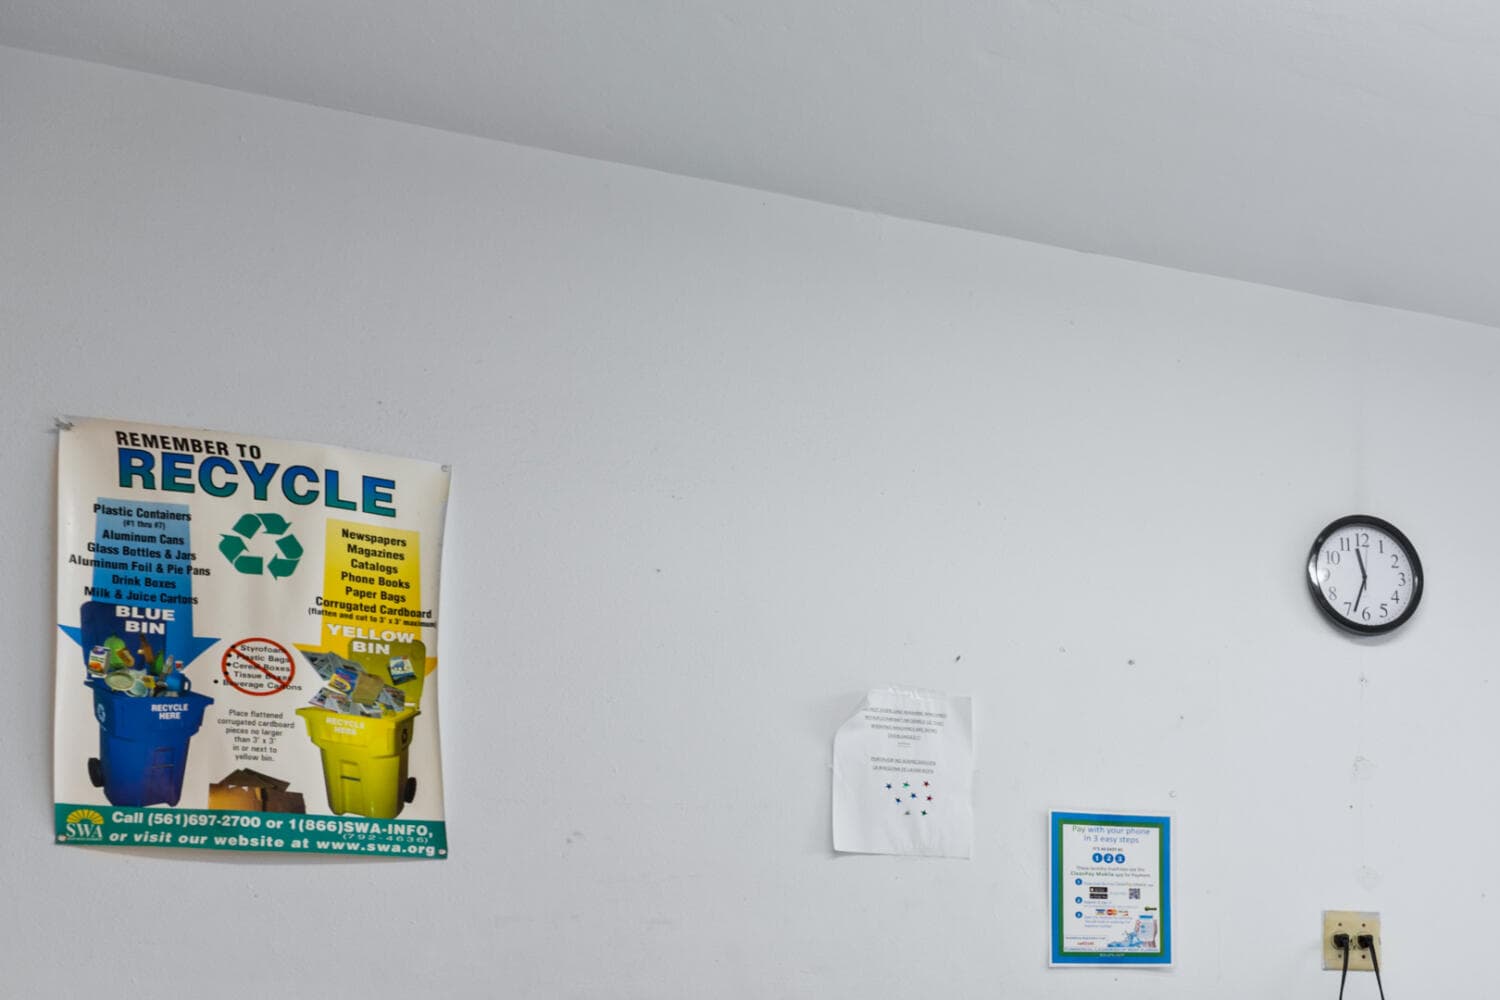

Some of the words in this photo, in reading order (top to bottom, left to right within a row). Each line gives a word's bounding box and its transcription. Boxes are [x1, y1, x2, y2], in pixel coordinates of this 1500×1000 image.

[115, 430, 229, 456] REMEMBER
[236, 443, 261, 460] TO
[117, 447, 396, 518] RECYCLE
[93, 503, 133, 517] Plastic
[136, 508, 192, 521] Containers
[137, 521, 152, 529] thru
[102, 529, 157, 543] Aluminum
[160, 534, 185, 545] Cans
[341, 528, 407, 547] Newspapers
[1340, 537, 1350, 551] 11
[1355, 532, 1370, 548] 12
[87, 542, 120, 555] Glass
[122, 546, 162, 559] Bottles
[164, 549, 172, 559] &
[175, 550, 197, 561] Jars
[347, 543, 405, 561] Magazines
[1379, 540, 1384, 554] 1
[1325, 550, 1341, 565] 10
[1391, 554, 1400, 569] 2
[69, 554, 128, 571] Aluminum
[131, 561, 152, 573] Foil
[156, 563, 164, 574] &
[167, 564, 184, 576] Pie
[187, 566, 211, 577] Pans
[351, 558, 399, 575] Catalogs
[112, 574, 141, 586] Drink
[144, 577, 177, 589] Boxes
[341, 571, 375, 585] Phone
[378, 576, 411, 590] Books
[1398, 572, 1406, 587] 3
[84, 586, 110, 599] Milk
[114, 589, 123, 600] &
[126, 590, 158, 602] Juice
[160, 593, 199, 605] Cartons
[345, 586, 377, 600] Paper
[380, 591, 407, 603] Bags
[1328, 586, 1338, 601] 8
[1391, 590, 1400, 605] 4
[115, 605, 175, 622] BLUE
[308, 607, 338, 618] (flatten
[340, 611, 353, 620] and
[356, 613, 368, 622] cut
[370, 614, 378, 622] to
[316, 596, 377, 613] Corrugated
[380, 605, 432, 619] Cardboard
[1344, 602, 1352, 616] 7
[1362, 607, 1371, 621] 6
[1379, 603, 1388, 618] 5
[125, 621, 166, 635] BIN
[327, 623, 416, 643] YELLOW
[352, 641, 390, 655] BIN
[232, 661, 262, 670] Cere
[236, 654, 266, 662] Pstic
[234, 671, 263, 679] Tissue
[223, 679, 264, 689] Bverage
[267, 682, 302, 691] Caons
[151, 704, 189, 712] RECYCLE
[229, 709, 249, 718] Place
[250, 710, 283, 719] flattened
[217, 718, 257, 727] corrugated
[258, 720, 295, 729] cardboard
[261, 729, 282, 738] larger
[235, 753, 259, 761] yellow
[66, 823, 103, 838] SWA
[112, 811, 143, 824] Call
[147, 813, 261, 828] (561)697-2700
[266, 818, 283, 829] or
[289, 817, 433, 838] 1(866)SWA-INFO,
[1072, 825, 1086, 834] Pay
[1087, 825, 1105, 833] with
[1107, 826, 1125, 836] your
[1126, 827, 1150, 836] phone
[109, 831, 127, 842] or
[134, 830, 171, 844] visit
[178, 834, 208, 845] our
[214, 834, 284, 848] website
[291, 837, 309, 849] at
[316, 841, 436, 857] www.swa.org
[1084, 834, 1092, 842] in
[1100, 836, 1117, 844] easy
[1118, 836, 1139, 845] steps
